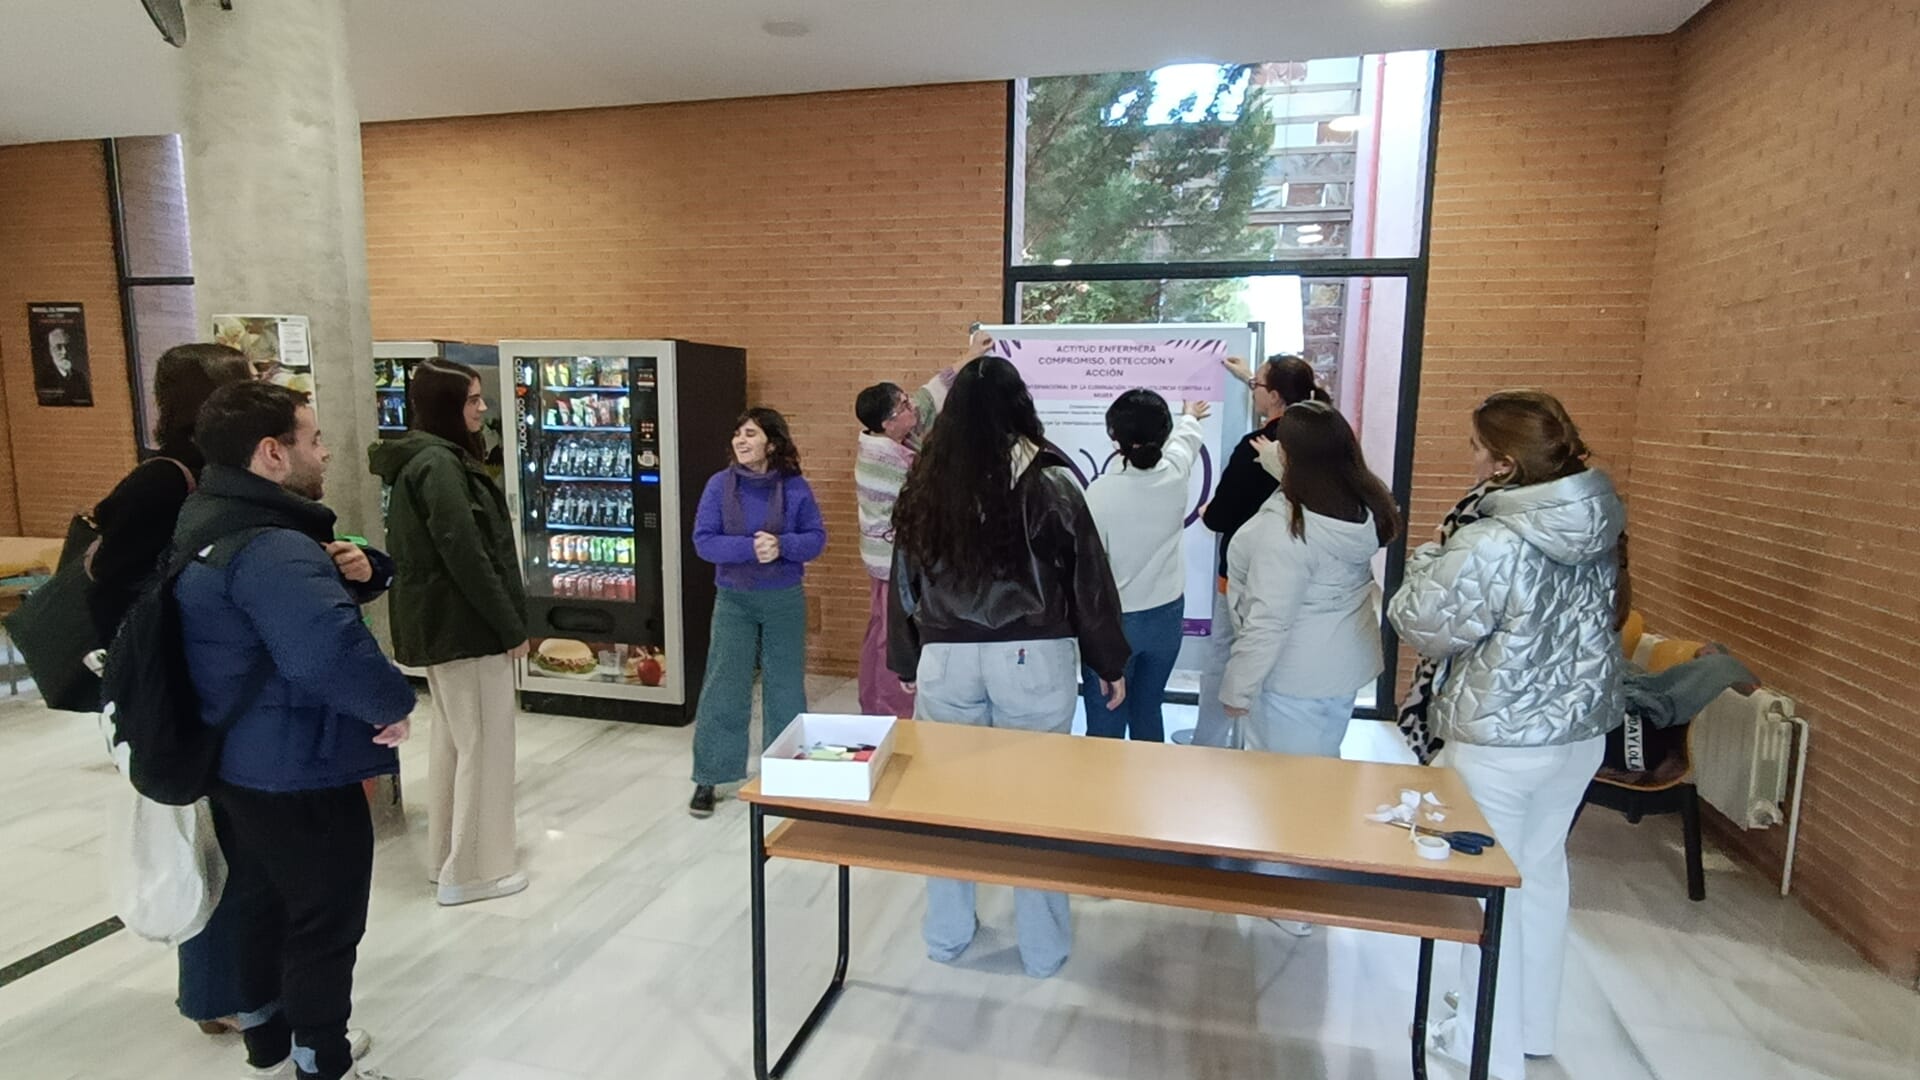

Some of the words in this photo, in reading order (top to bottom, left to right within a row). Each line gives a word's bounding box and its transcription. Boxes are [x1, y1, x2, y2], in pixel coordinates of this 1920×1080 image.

[1056, 345, 1097, 353] ACTITUD
[1098, 345, 1156, 353] ENFERMERA
[1109, 356, 1166, 366] DETECCIÓN
[1168, 357, 1175, 365] Y
[1085, 368, 1124, 377] ACCIÓN
